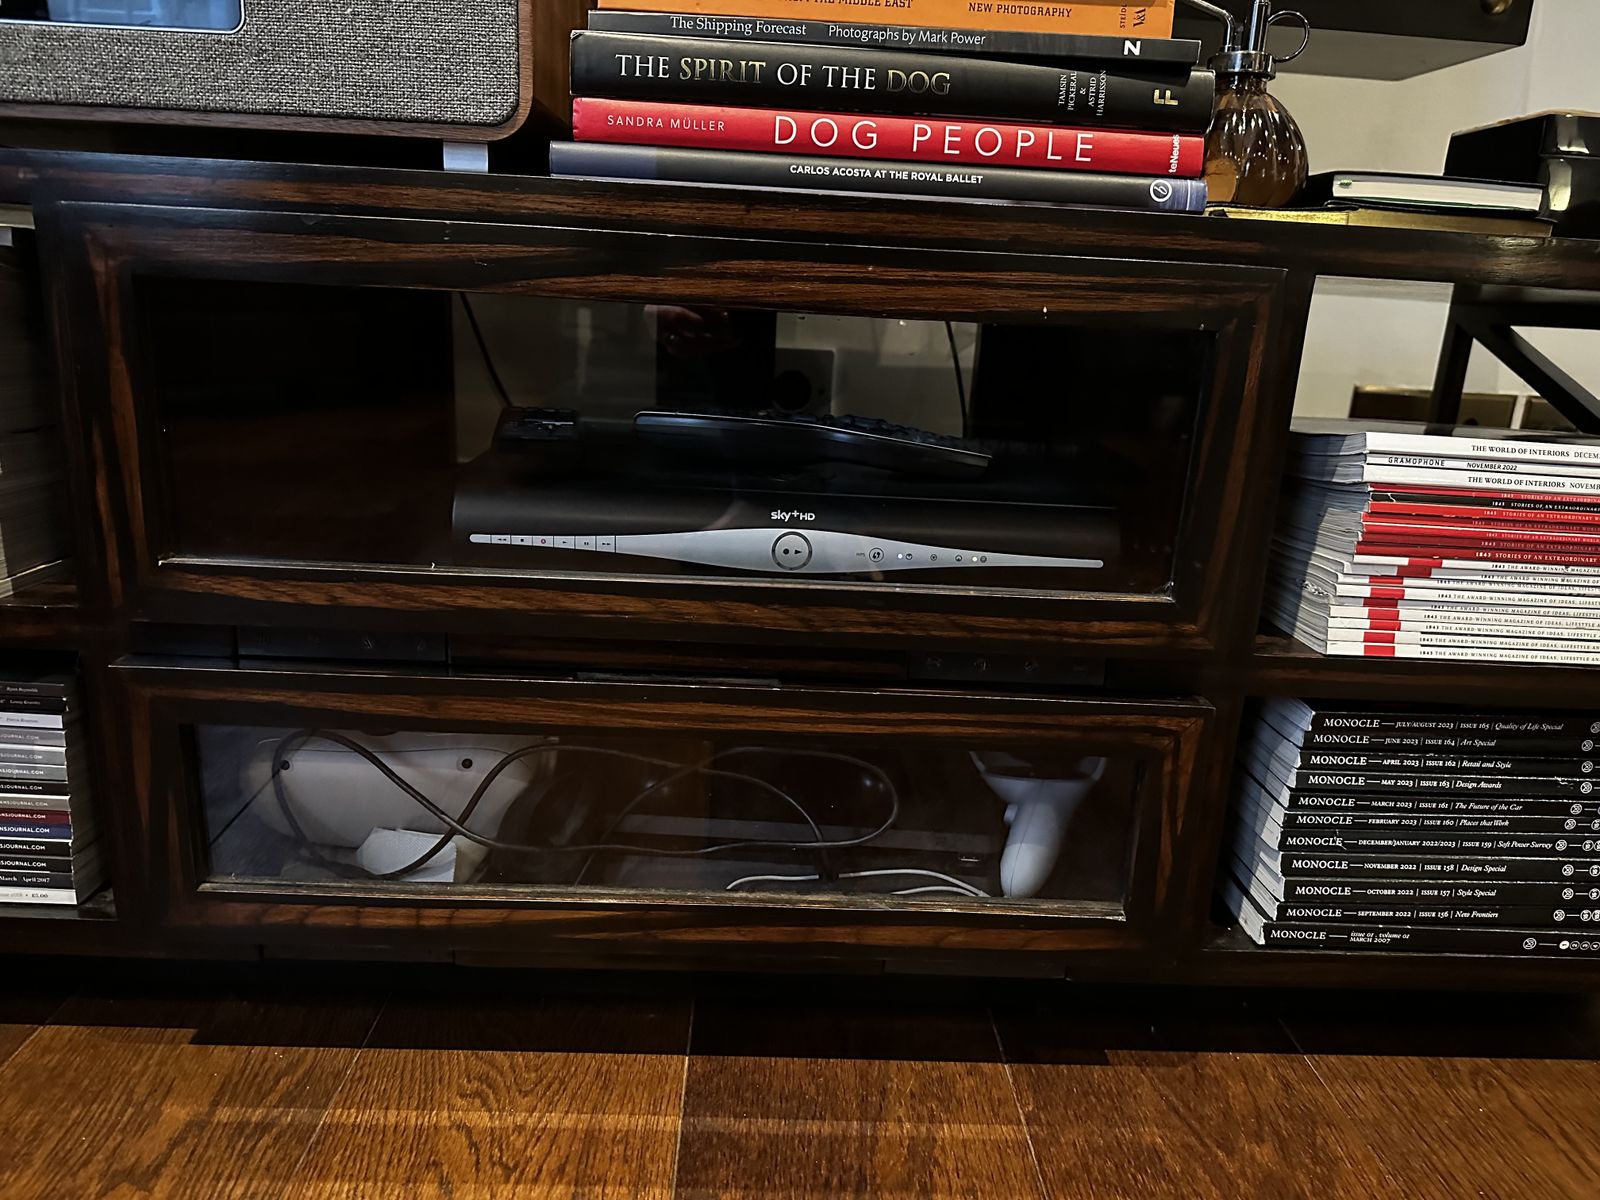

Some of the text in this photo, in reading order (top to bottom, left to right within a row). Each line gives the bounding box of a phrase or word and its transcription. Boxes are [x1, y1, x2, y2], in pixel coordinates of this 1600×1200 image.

[885, 0, 912, 8] EAST
[969, 2, 1072, 18] NEW PHOTOGRAPHY
[1133, 8, 1146, 28] V&A
[670, 16, 806, 35] The Shipping Forecast
[828, 25, 986, 45] Photographs by Mark Power
[1123, 40, 1141, 56] N
[614, 54, 951, 96] THE SPIRIT OF THE DOG
[1057, 74, 1067, 106] TAMSIN
[1067, 70, 1077, 110] PICKERAL
[1080, 87, 1086, 95] &
[1088, 77, 1097, 107] ASTRID
[1096, 70, 1107, 116] HARRISSON
[607, 114, 725, 132] SANDRA MÜLLER
[774, 115, 1094, 162] DOG PEOPLE
[1168, 134, 1180, 173] teNeues
[789, 164, 984, 184] CARLOS ACOSTA AT THE ROYAL BALLET
[1488, 446, 1516, 454] WORLD
[1529, 448, 1570, 457] INTERIORS
[1388, 457, 1445, 467] GRAMOPHONE
[1466, 462, 1501, 470] NOVEMBER
[1525, 480, 1566, 488] INTERIORS
[1545, 555, 1597, 563] EXTRAORDINARY
[1448, 651, 1497, 659] AWARD-WINNING
[1323, 718, 1380, 728] MONOCLE
[1495, 722, 1518, 731] Quality
[1540, 723, 1564, 731] Special
[1313, 734, 1370, 744] MONOCLE
[1473, 739, 1496, 747] Special
[1310, 755, 1367, 766] MONOCLE
[1495, 761, 1512, 769] Style
[1308, 775, 1366, 786] MONOCLE
[1455, 781, 1476, 789] Design
[1478, 781, 1502, 789] Awards
[1298, 798, 1355, 807] MONOCLE
[1491, 803, 1498, 811] of
[1296, 816, 1353, 825] MONOCLE
[1286, 837, 1343, 846] MONOCLE
[1358, 839, 1420, 847] DECEMBER/JANUARY
[1483, 841, 1492, 849] 159
[1497, 841, 1510, 849] Soft
[1511, 841, 1530, 849] Power
[1530, 842, 1553, 850] Survey
[1292, 860, 1349, 869] MONOCLE
[1443, 864, 1454, 872] 158
[1461, 864, 1482, 873] Design
[1483, 865, 1507, 873] Special
[1295, 886, 1351, 896] MONOCLE
[1457, 889, 1473, 897] Style
[1474, 889, 1497, 897] Special
[1286, 908, 1342, 917] MONOCLE
[1437, 911, 1449, 919] 156
[1270, 930, 1326, 939] MONOCLE
